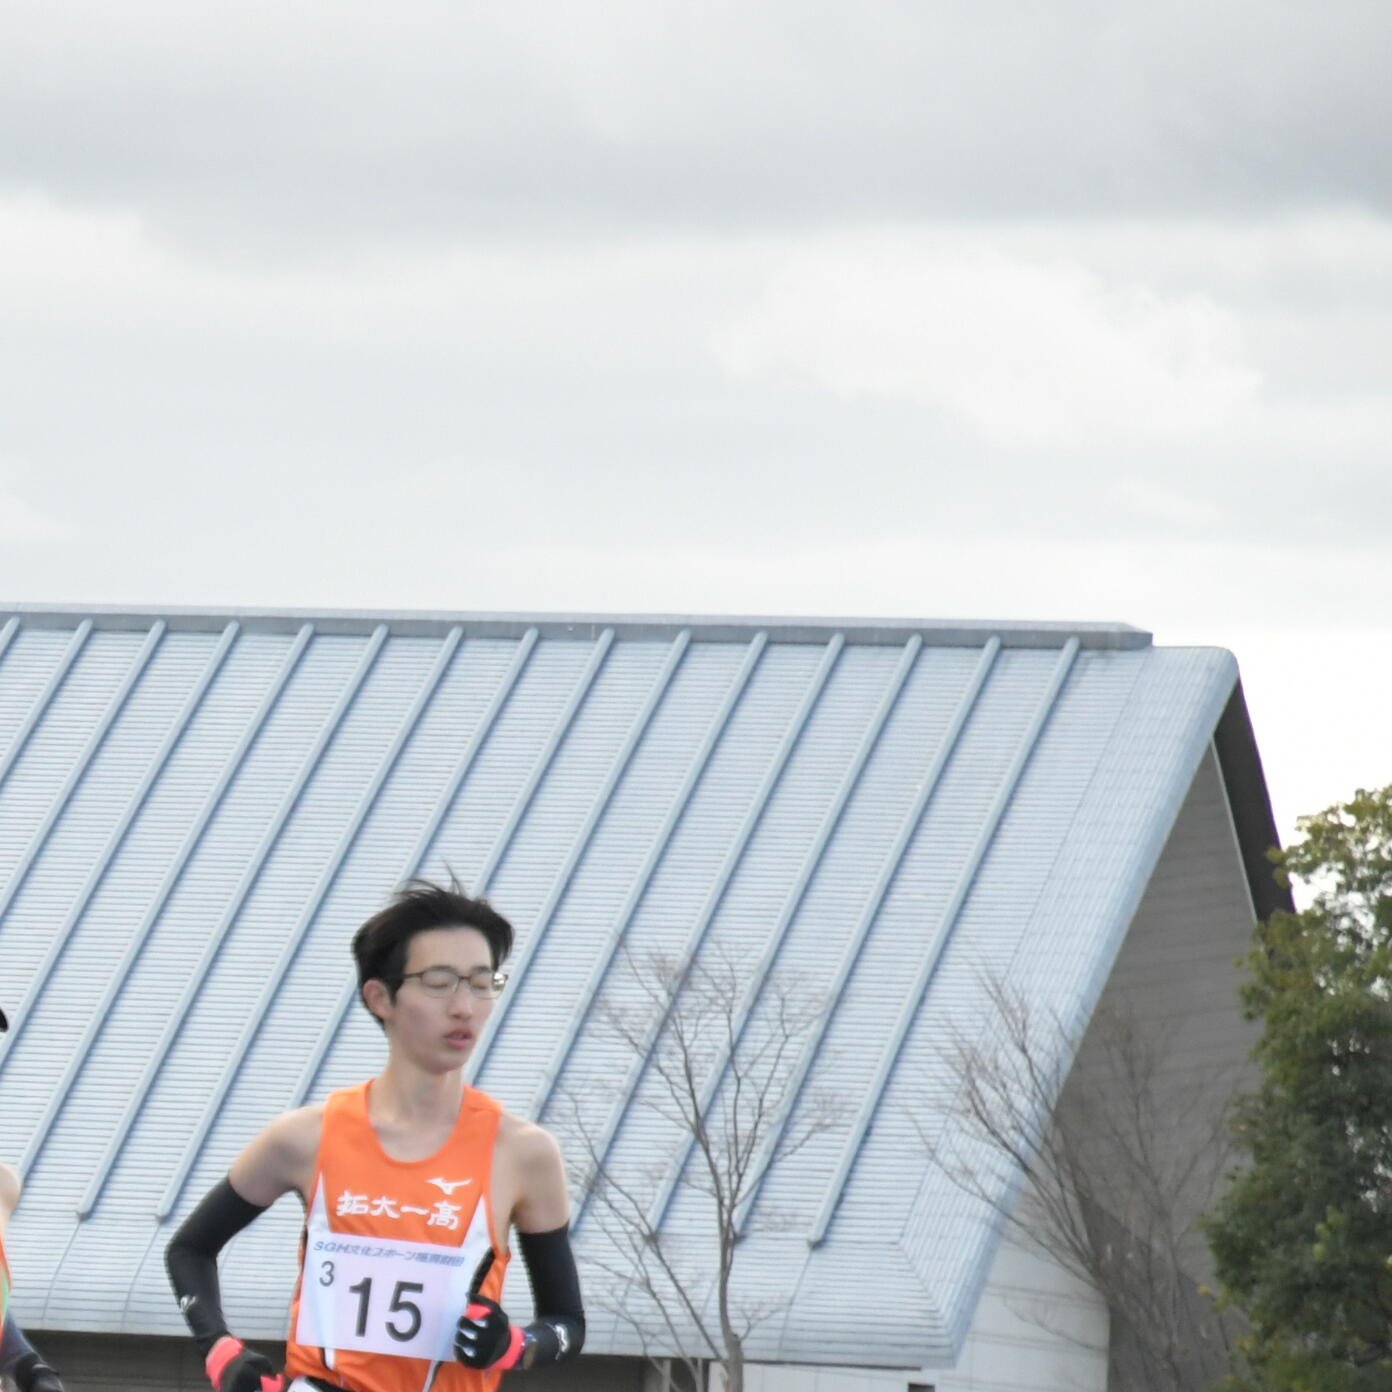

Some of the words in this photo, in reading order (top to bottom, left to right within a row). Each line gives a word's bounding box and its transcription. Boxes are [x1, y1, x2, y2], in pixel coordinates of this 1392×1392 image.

[336, 1189, 463, 1230] 拓大一高
[319, 1261, 335, 1287] 3
[349, 1277, 424, 1342] 15
